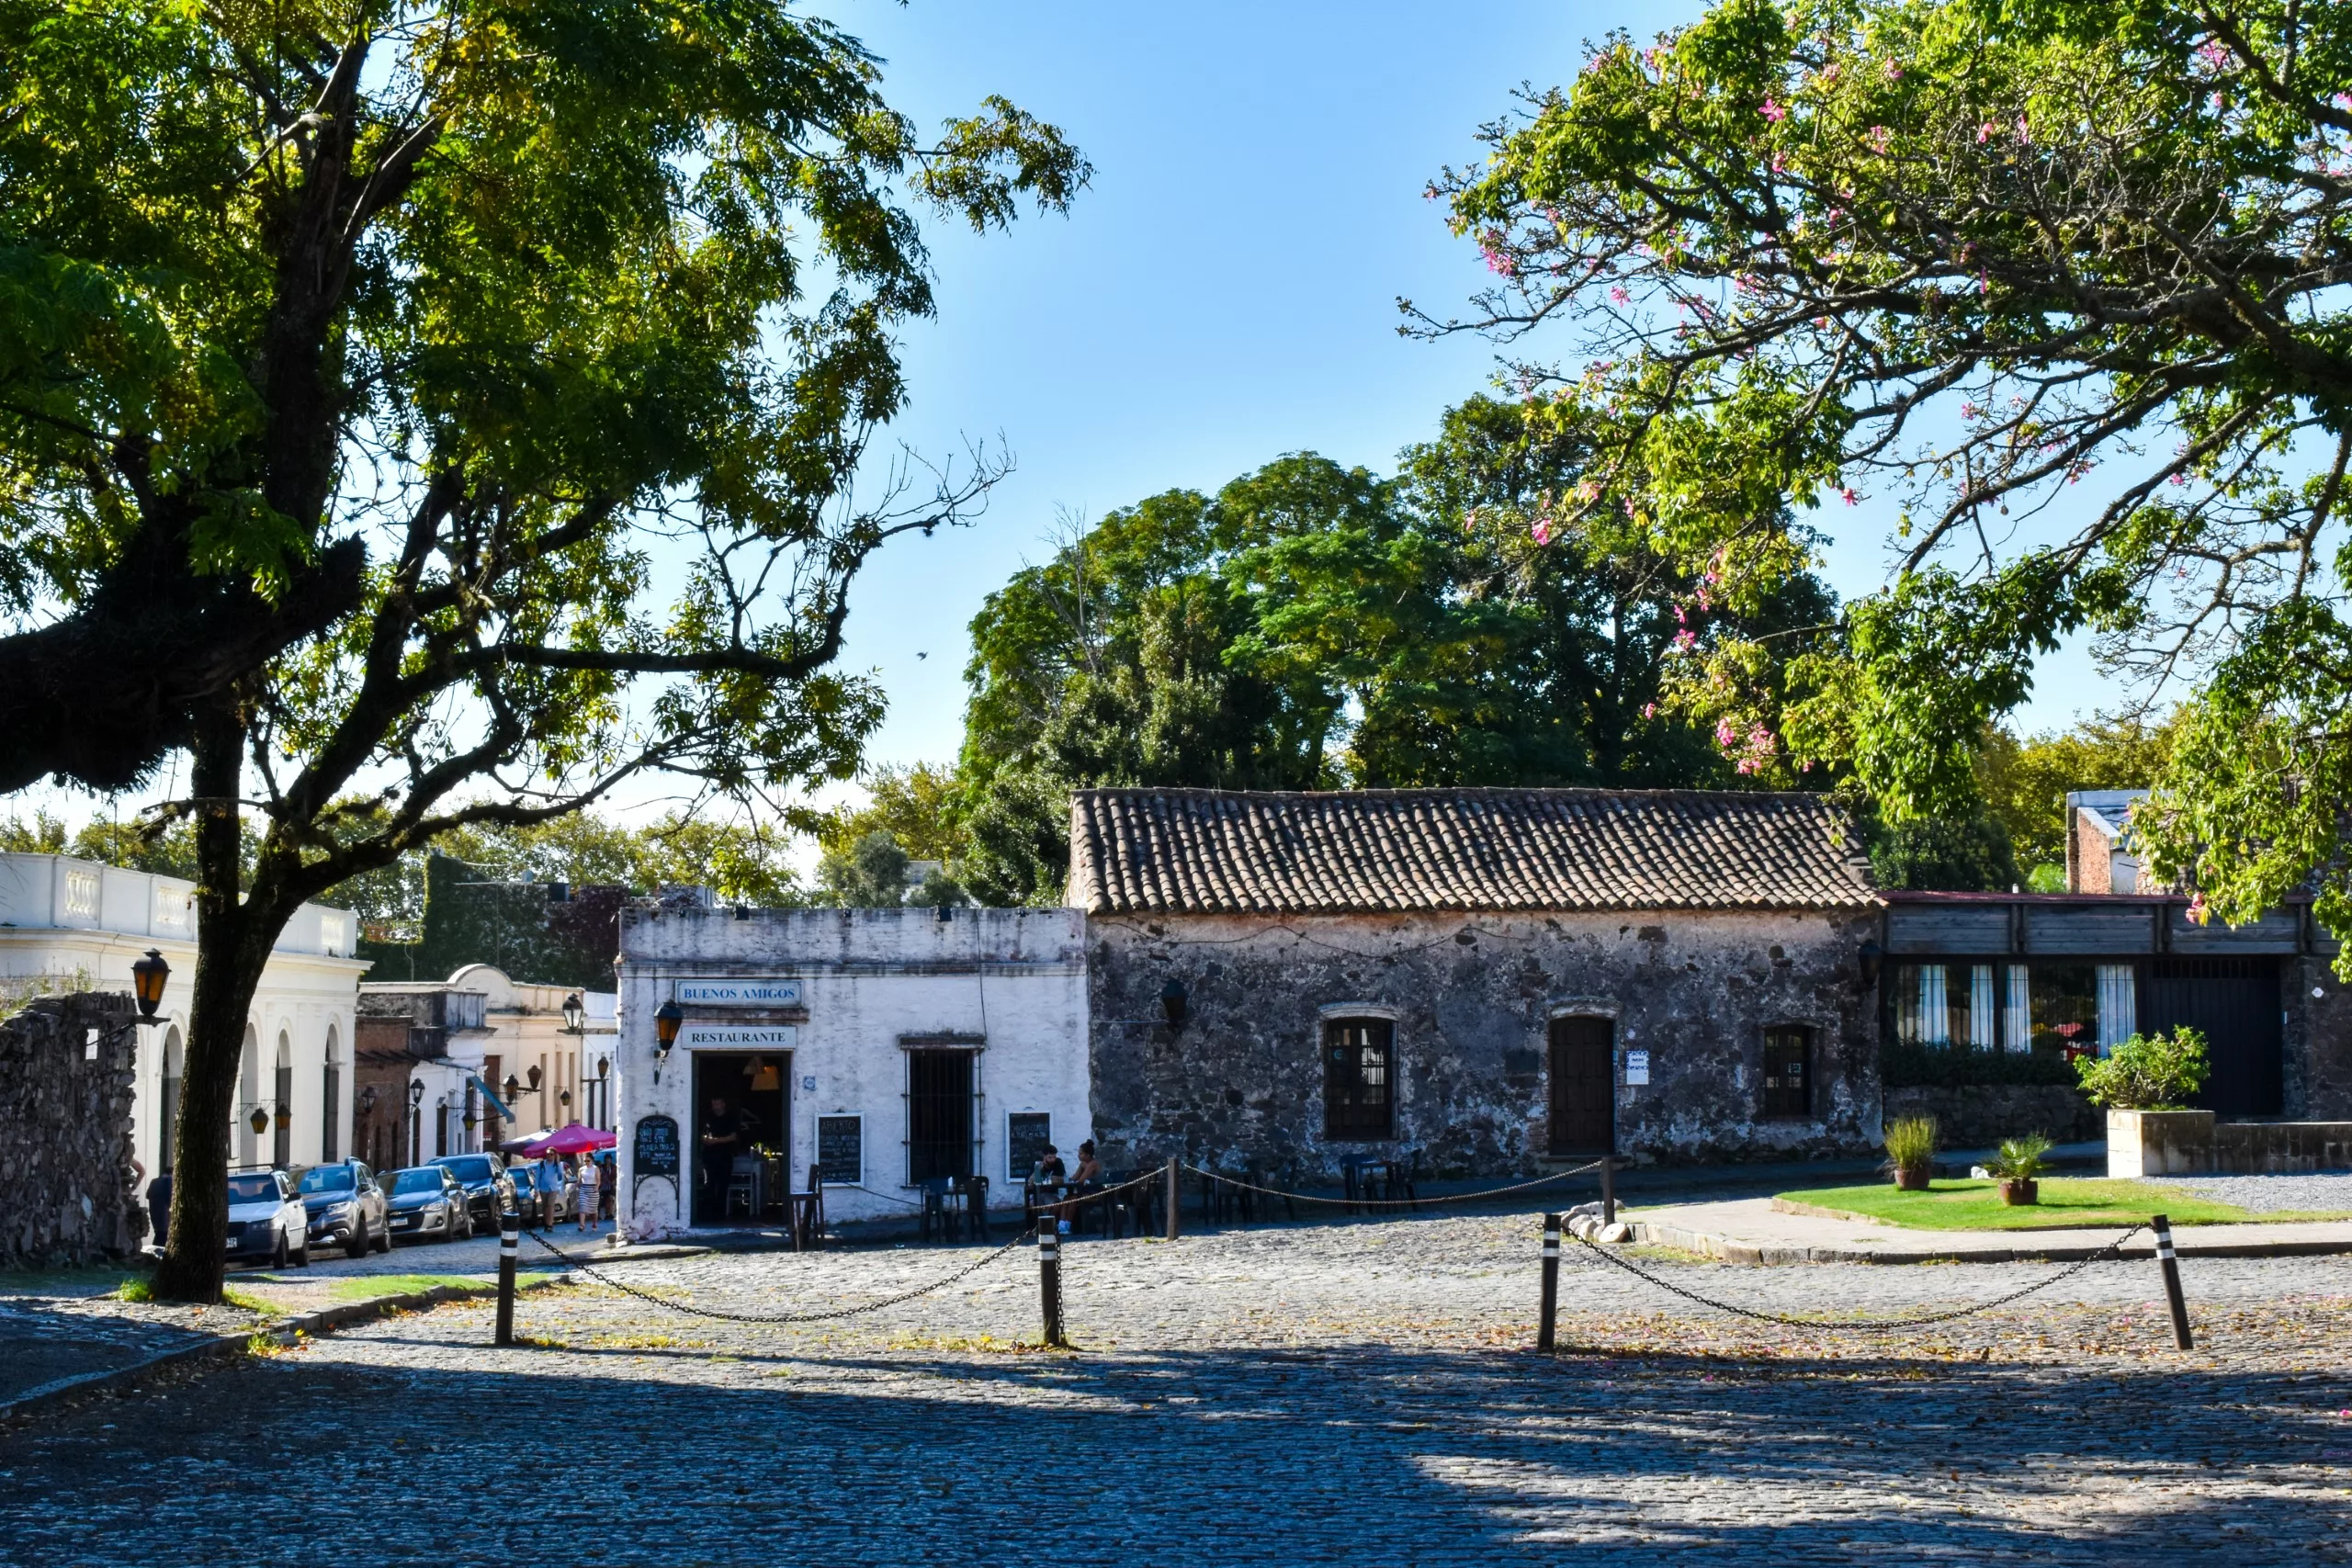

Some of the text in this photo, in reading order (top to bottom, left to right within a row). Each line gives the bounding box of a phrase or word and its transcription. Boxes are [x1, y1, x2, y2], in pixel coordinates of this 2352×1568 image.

[684, 988, 795, 999] BUENOS AMIGOS
[691, 1032, 786, 1043] RESTAURANTE
